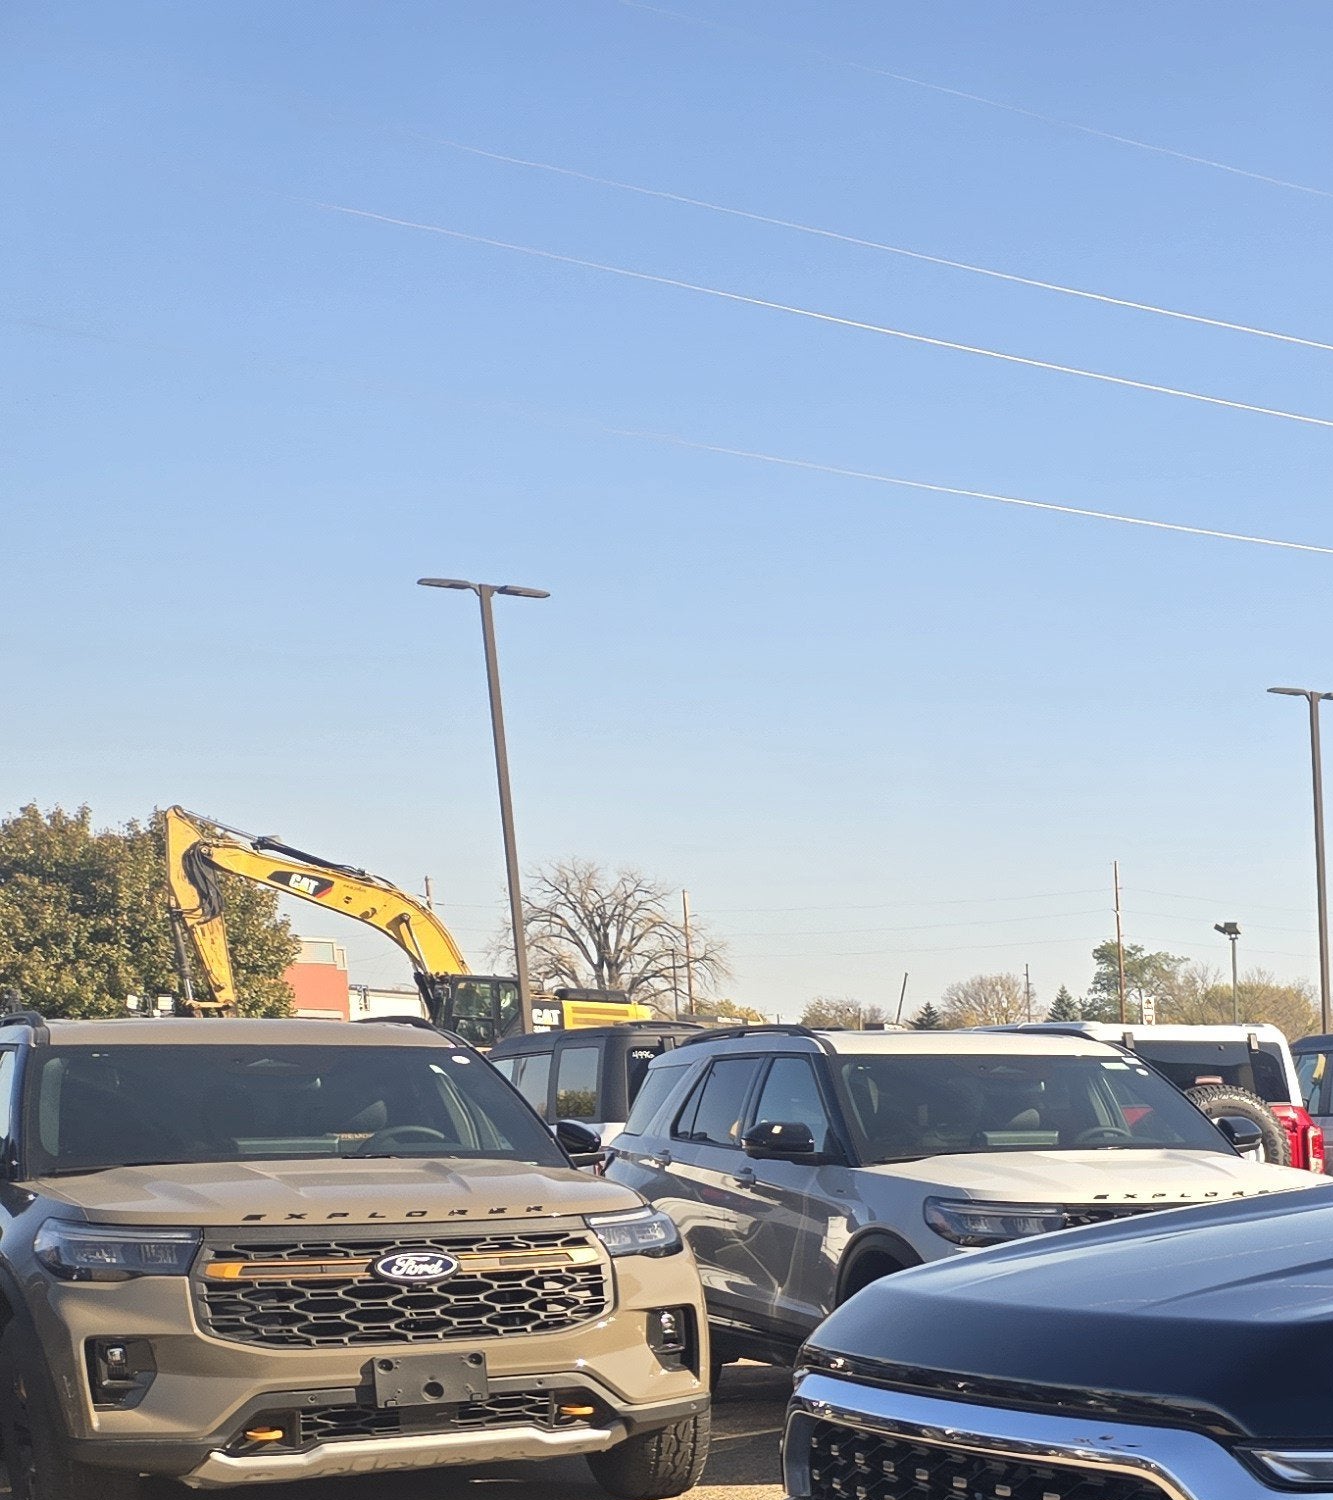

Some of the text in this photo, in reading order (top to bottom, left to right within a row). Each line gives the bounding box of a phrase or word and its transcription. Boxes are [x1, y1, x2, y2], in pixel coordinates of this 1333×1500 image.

[288, 873, 319, 895] CAT
[532, 1008, 561, 1025] CAT
[242, 1205, 543, 1222] EXPLORER
